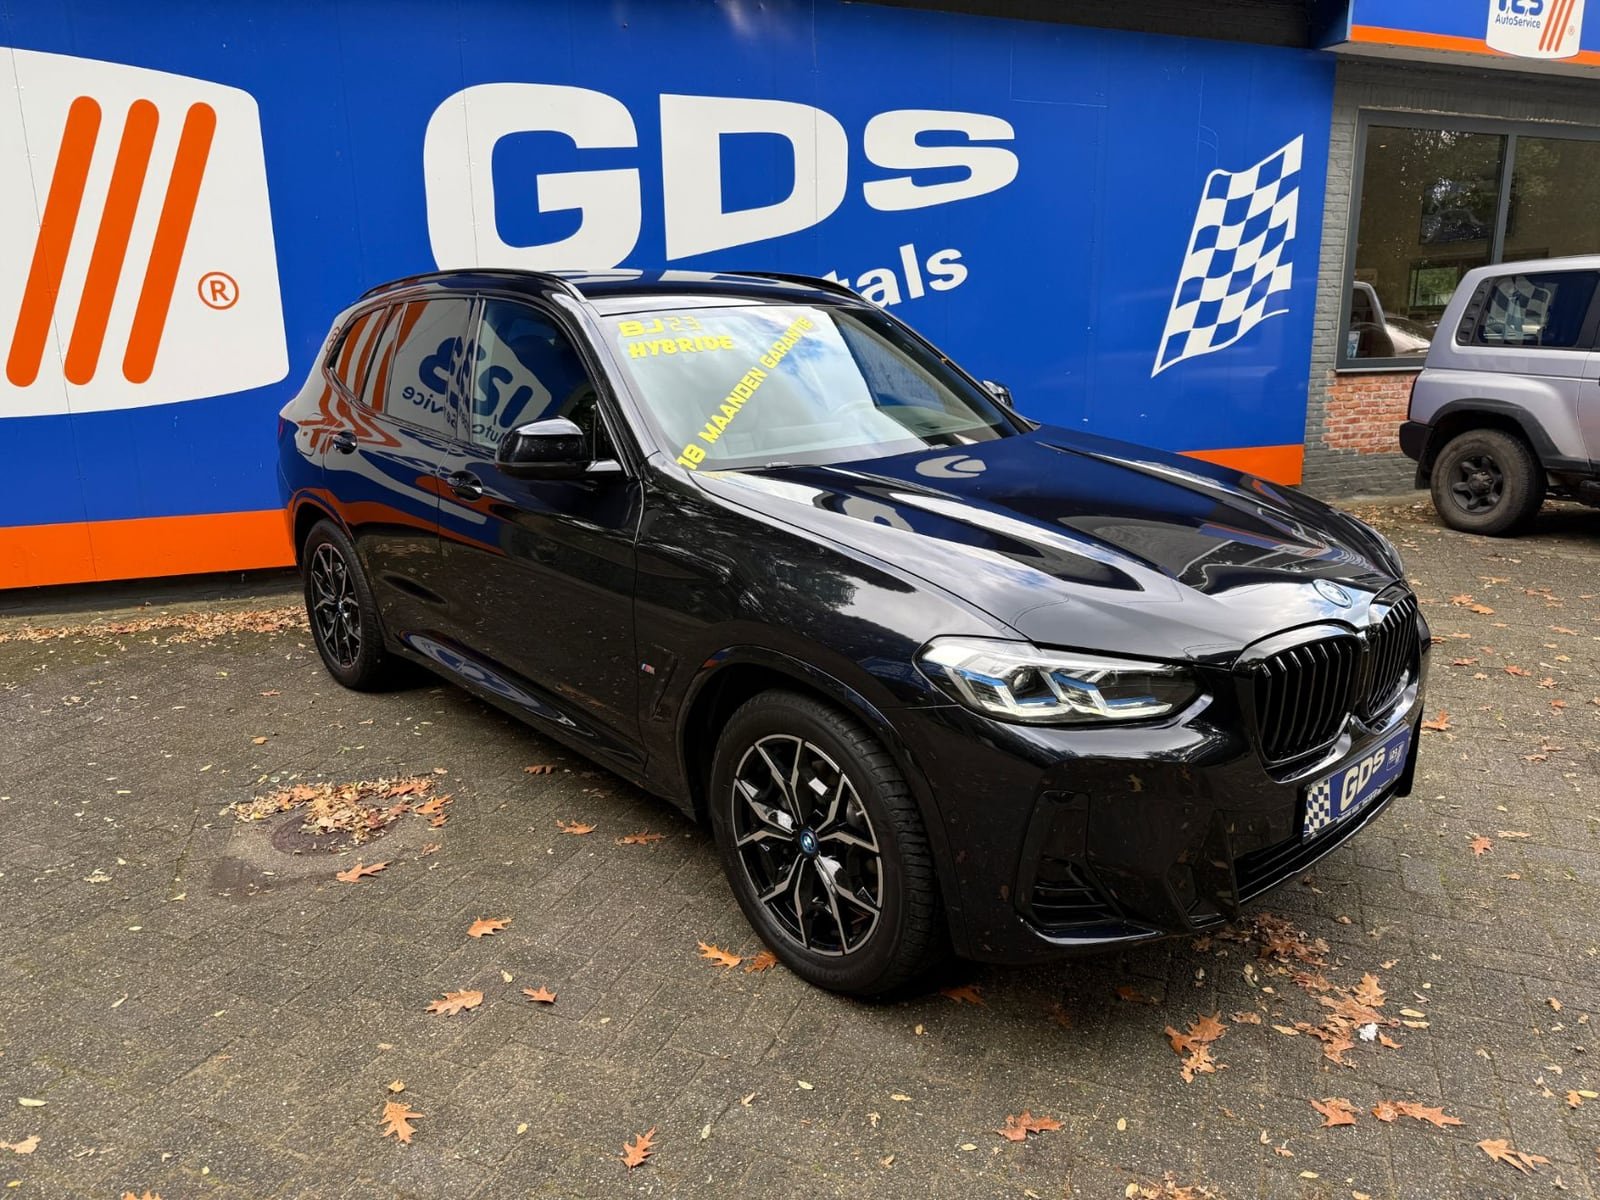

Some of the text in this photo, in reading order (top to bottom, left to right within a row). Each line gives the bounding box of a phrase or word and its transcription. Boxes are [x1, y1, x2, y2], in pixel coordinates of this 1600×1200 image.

[1495, 14, 1541, 29] AutoService
[423, 82, 1019, 270] GDS
[617, 319, 665, 337] BJ
[628, 335, 734, 359] HYBRIDE
[676, 443, 706, 470] 18
[698, 366, 768, 444] MAANDEN
[1340, 747, 1385, 812] GDS
